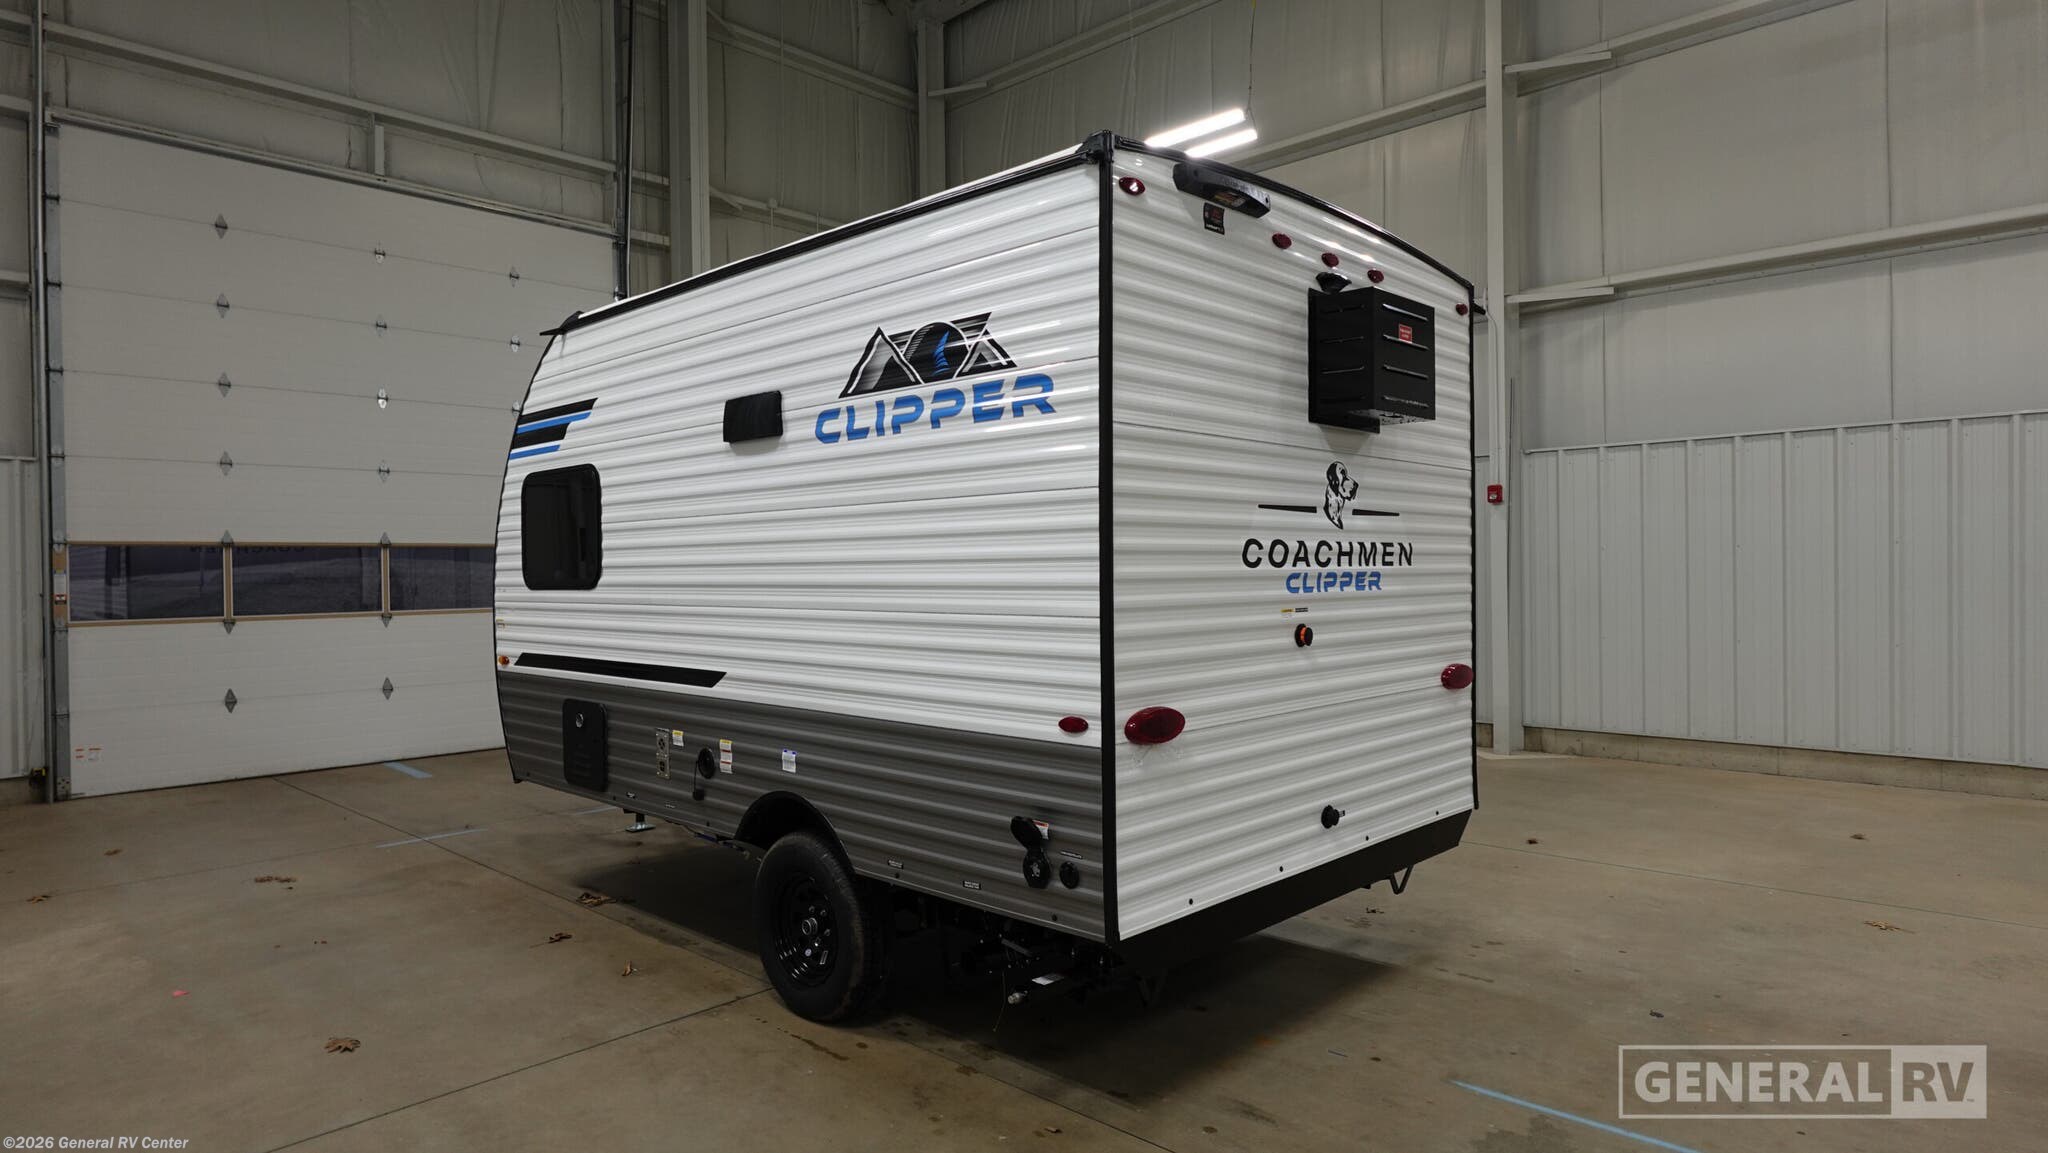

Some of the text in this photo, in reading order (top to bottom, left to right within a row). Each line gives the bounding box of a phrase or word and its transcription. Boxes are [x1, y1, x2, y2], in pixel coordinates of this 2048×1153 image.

[815, 373, 1056, 444] CLIPPER
[1242, 538, 1413, 568] COACHMEN
[1286, 571, 1382, 593] CLIPPER
